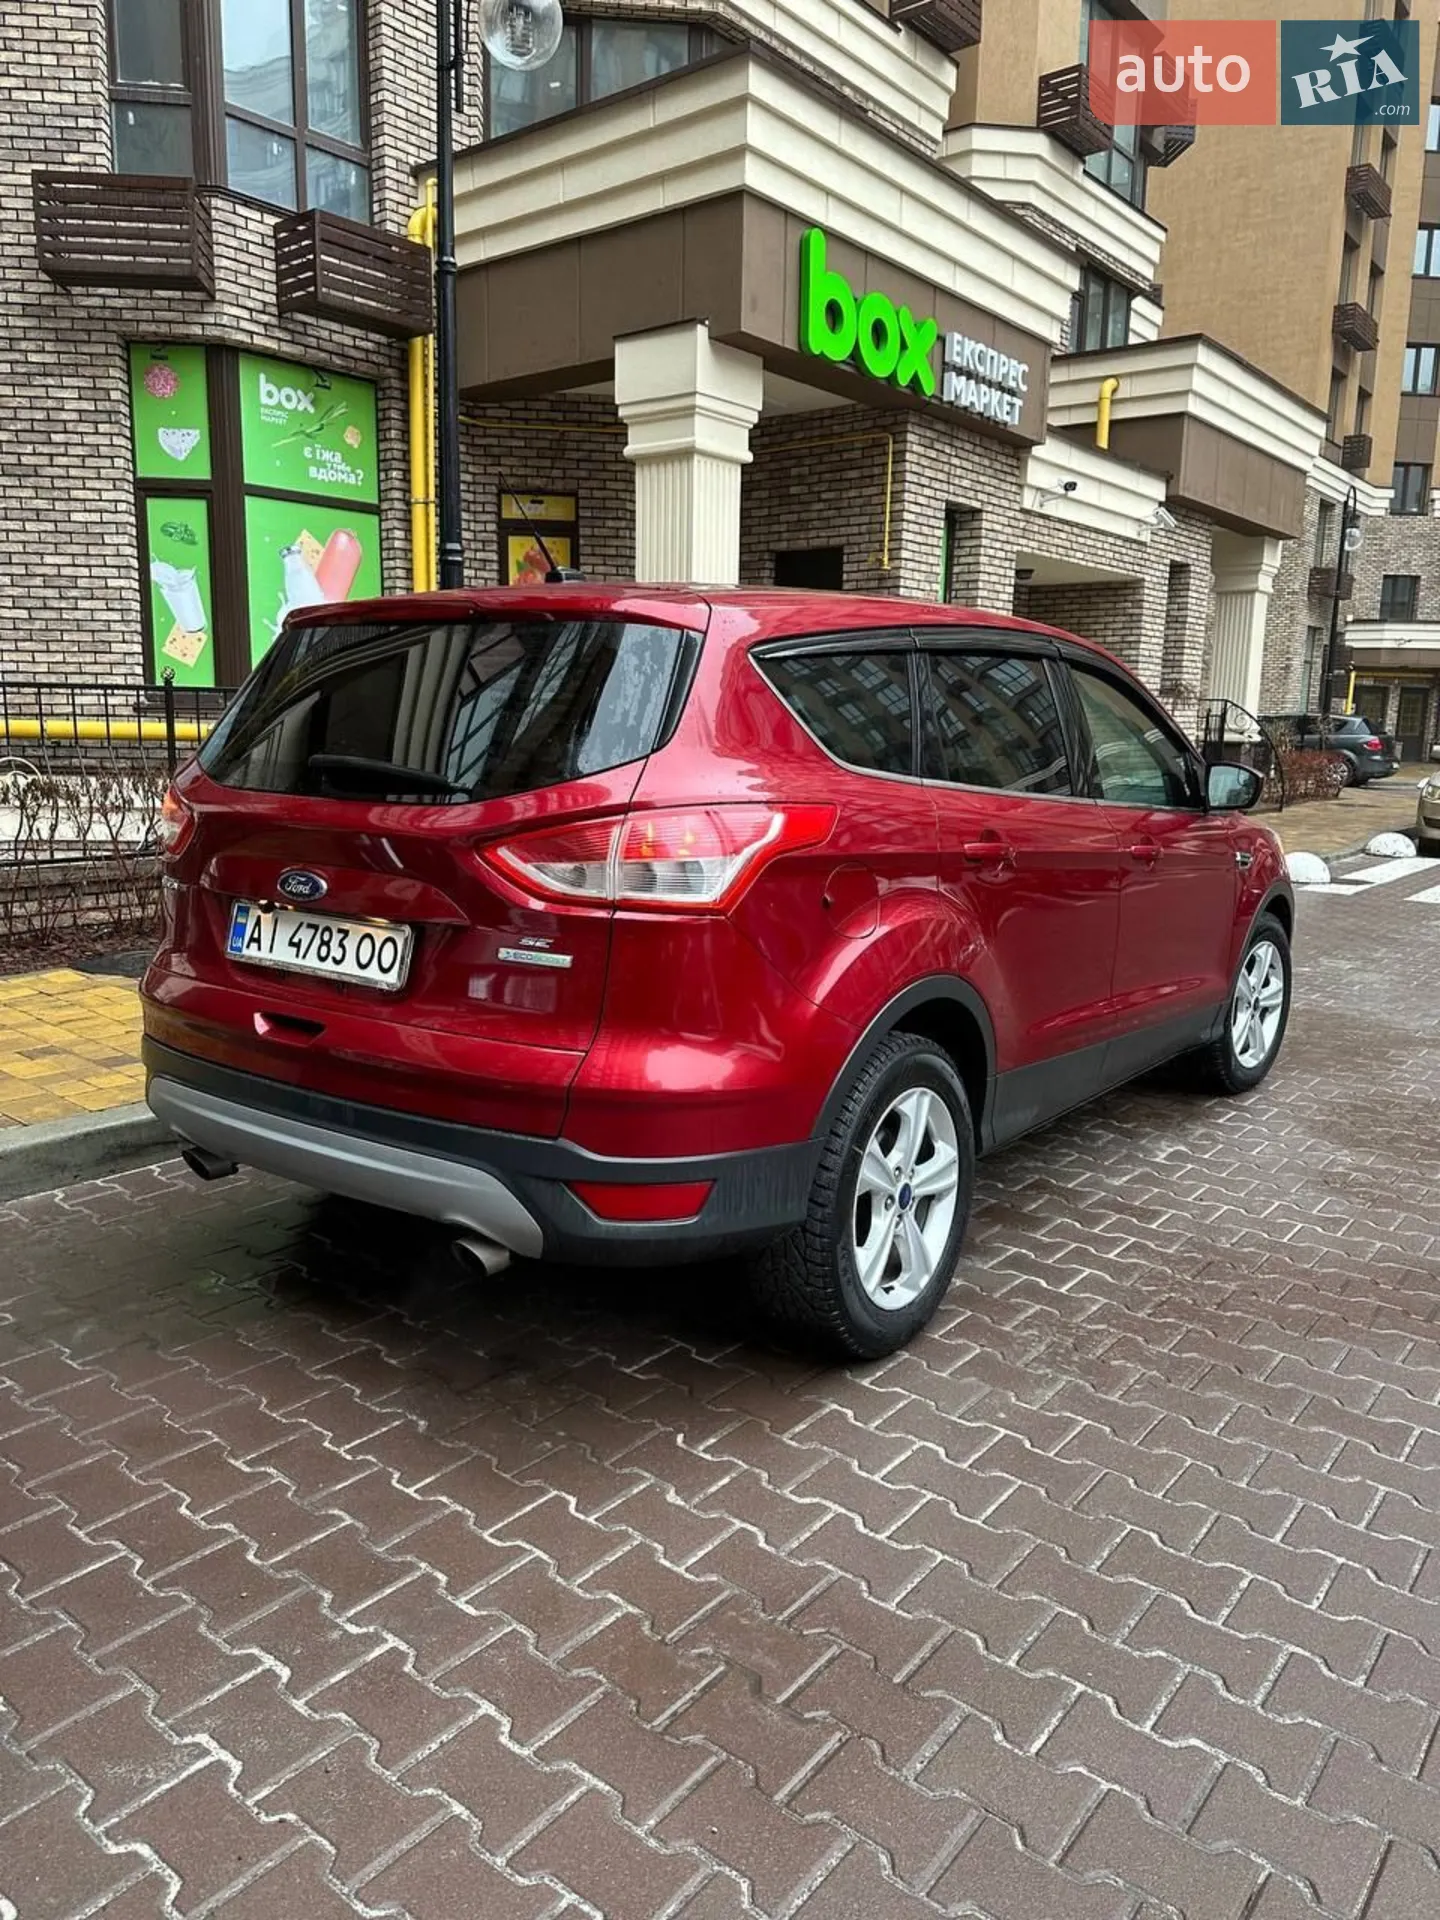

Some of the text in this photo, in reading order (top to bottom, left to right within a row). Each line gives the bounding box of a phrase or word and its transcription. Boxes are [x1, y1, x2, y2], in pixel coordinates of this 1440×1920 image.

[800, 227, 938, 397] box
[945, 332, 1029, 392] ЕКСПРЕС
[259, 373, 315, 414] box
[943, 371, 1024, 426] МАРКЕТ
[308, 466, 364, 487] вдома?
[284, 875, 311, 895] Ford
[246, 914, 399, 974] AI 4783 OO
